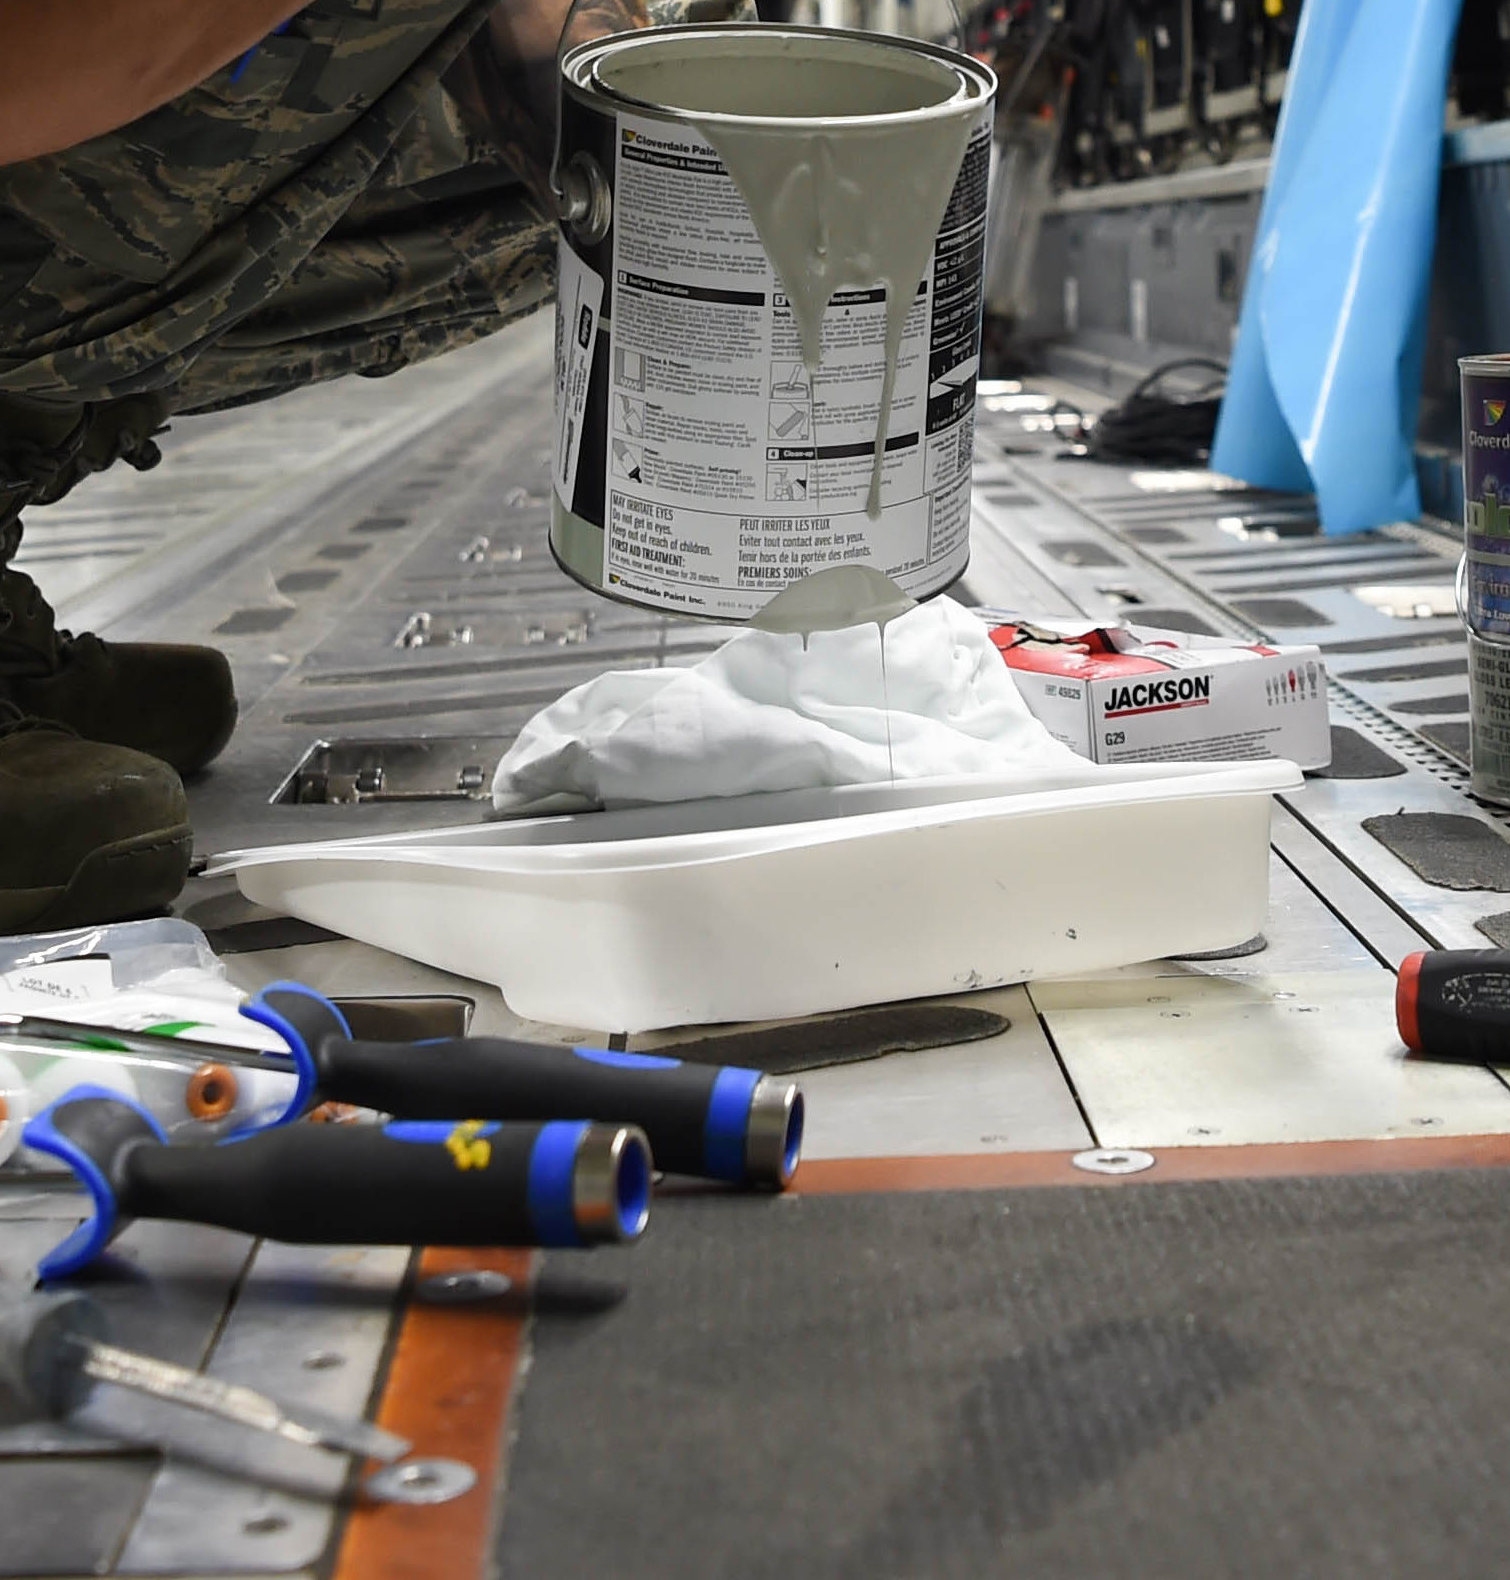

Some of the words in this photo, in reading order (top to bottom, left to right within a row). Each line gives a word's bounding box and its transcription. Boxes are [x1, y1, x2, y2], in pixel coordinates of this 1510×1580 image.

[635, 134, 690, 154] Cloverdale
[612, 494, 626, 508] MAY
[626, 498, 653, 517] IRRITATE
[655, 506, 674, 521] EYES
[612, 507, 621, 520] Do
[622, 511, 633, 522] not
[634, 515, 645, 530] get
[646, 519, 653, 531] in
[654, 523, 673, 536] eyes.
[739, 518, 759, 532] PEUT
[761, 518, 793, 532] IRRITER
[795, 519, 809, 532] LES
[811, 518, 831, 531] YEUX
[611, 523, 627, 539] Keep
[627, 529, 639, 542] out
[639, 531, 647, 544] of
[648, 534, 669, 548] reach
[670, 537, 678, 551] of
[679, 540, 713, 556] children.
[739, 533, 762, 547] Eviter
[764, 535, 781, 548] tout
[782, 534, 812, 548] contact
[814, 535, 832, 547] avec
[833, 532, 845, 545] les
[846, 532, 866, 546] yeux.
[611, 537, 628, 553] FIRST
[629, 543, 641, 558] AID
[642, 547, 686, 568] TREATMENT:
[738, 550, 758, 563] Tenir
[759, 550, 777, 563] hors
[779, 551, 789, 564] de
[791, 550, 799, 563] la
[800, 550, 827, 566] portée
[828, 548, 842, 561] des
[843, 546, 872, 560] enfants.
[738, 565, 781, 579] PREMIERS
[783, 566, 813, 579] SOINS:
[619, 578, 662, 598] Cloverdale
[663, 589, 686, 603] Paint
[688, 594, 706, 607] Inc.
[1103, 675, 1211, 712] JACKSON
[1104, 731, 1126, 747] G29
